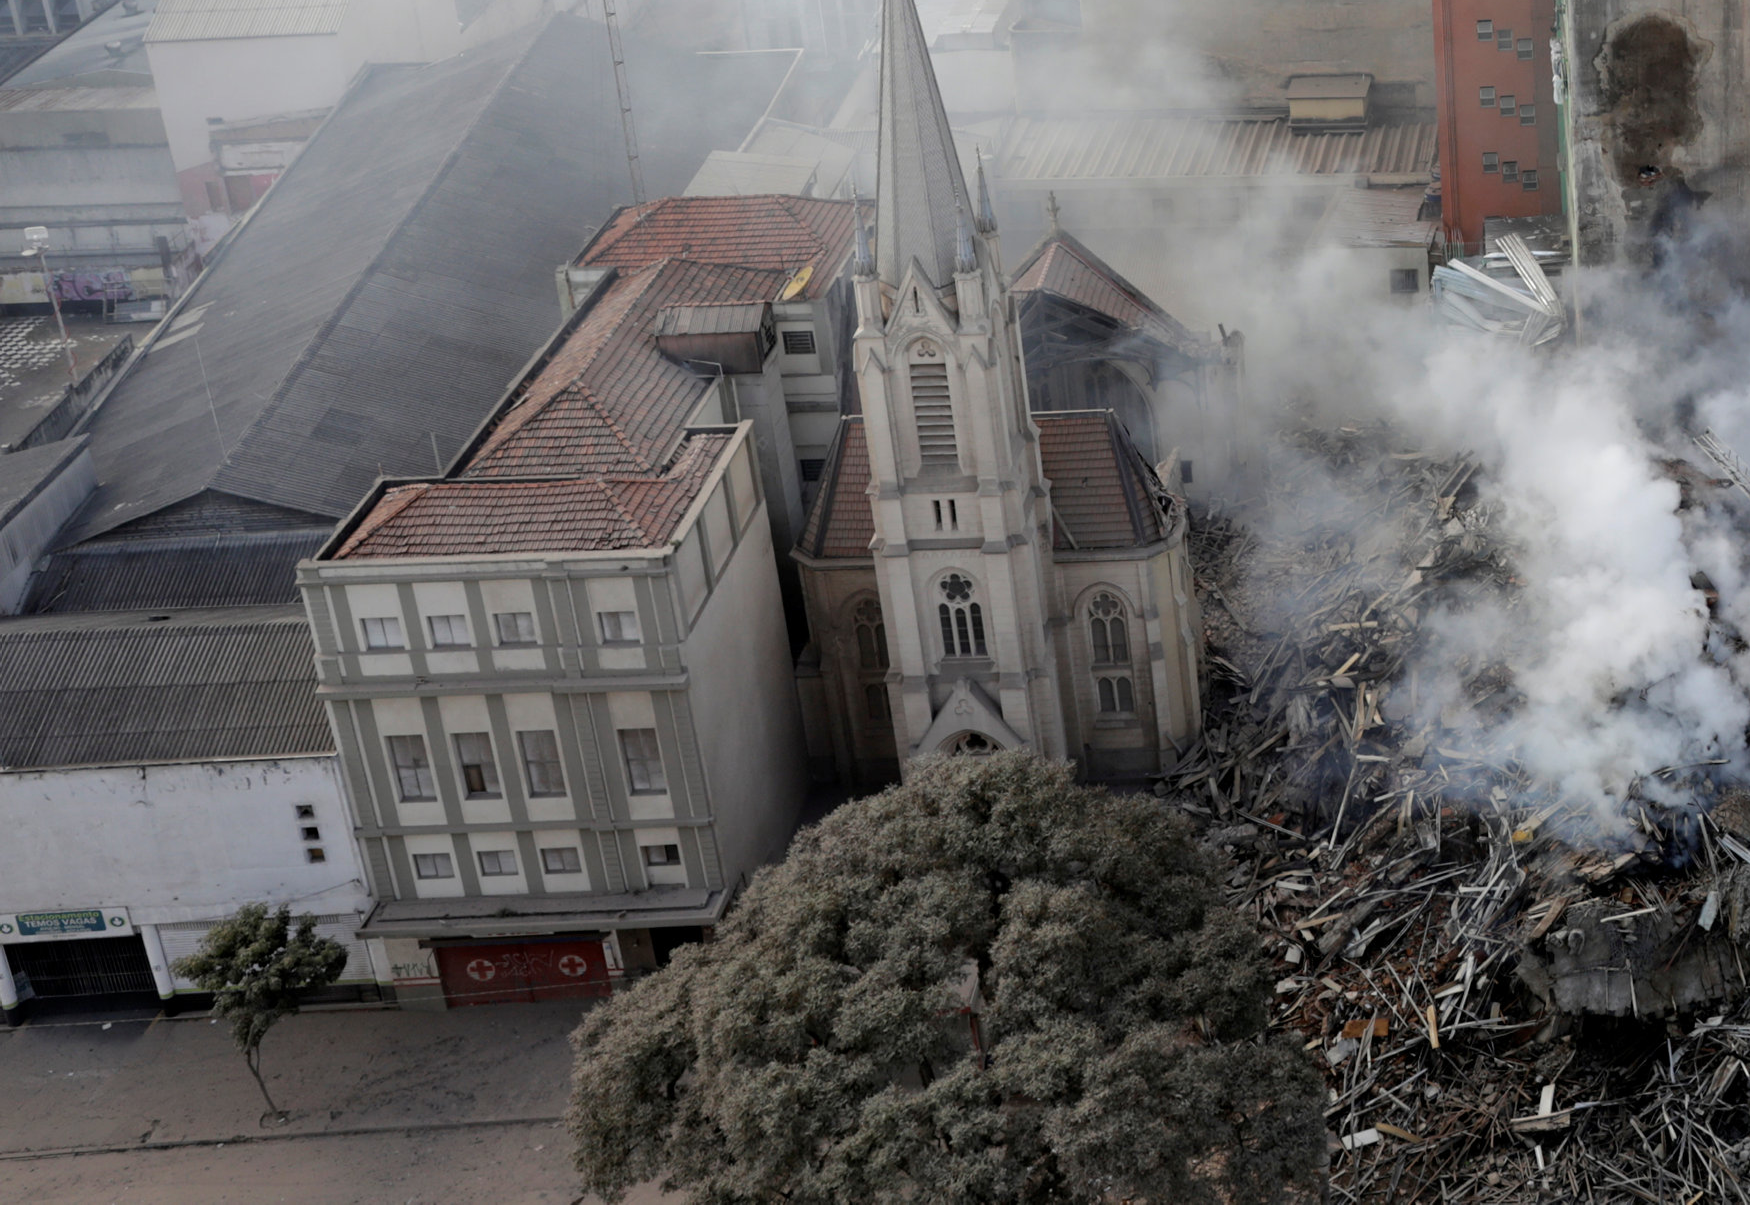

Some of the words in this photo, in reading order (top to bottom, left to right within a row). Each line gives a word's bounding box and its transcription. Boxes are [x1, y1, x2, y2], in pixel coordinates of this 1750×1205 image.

[18, 910, 100, 922] Estacionamento
[24, 919, 60, 928] TEMOS
[61, 917, 97, 926] VAGAS
